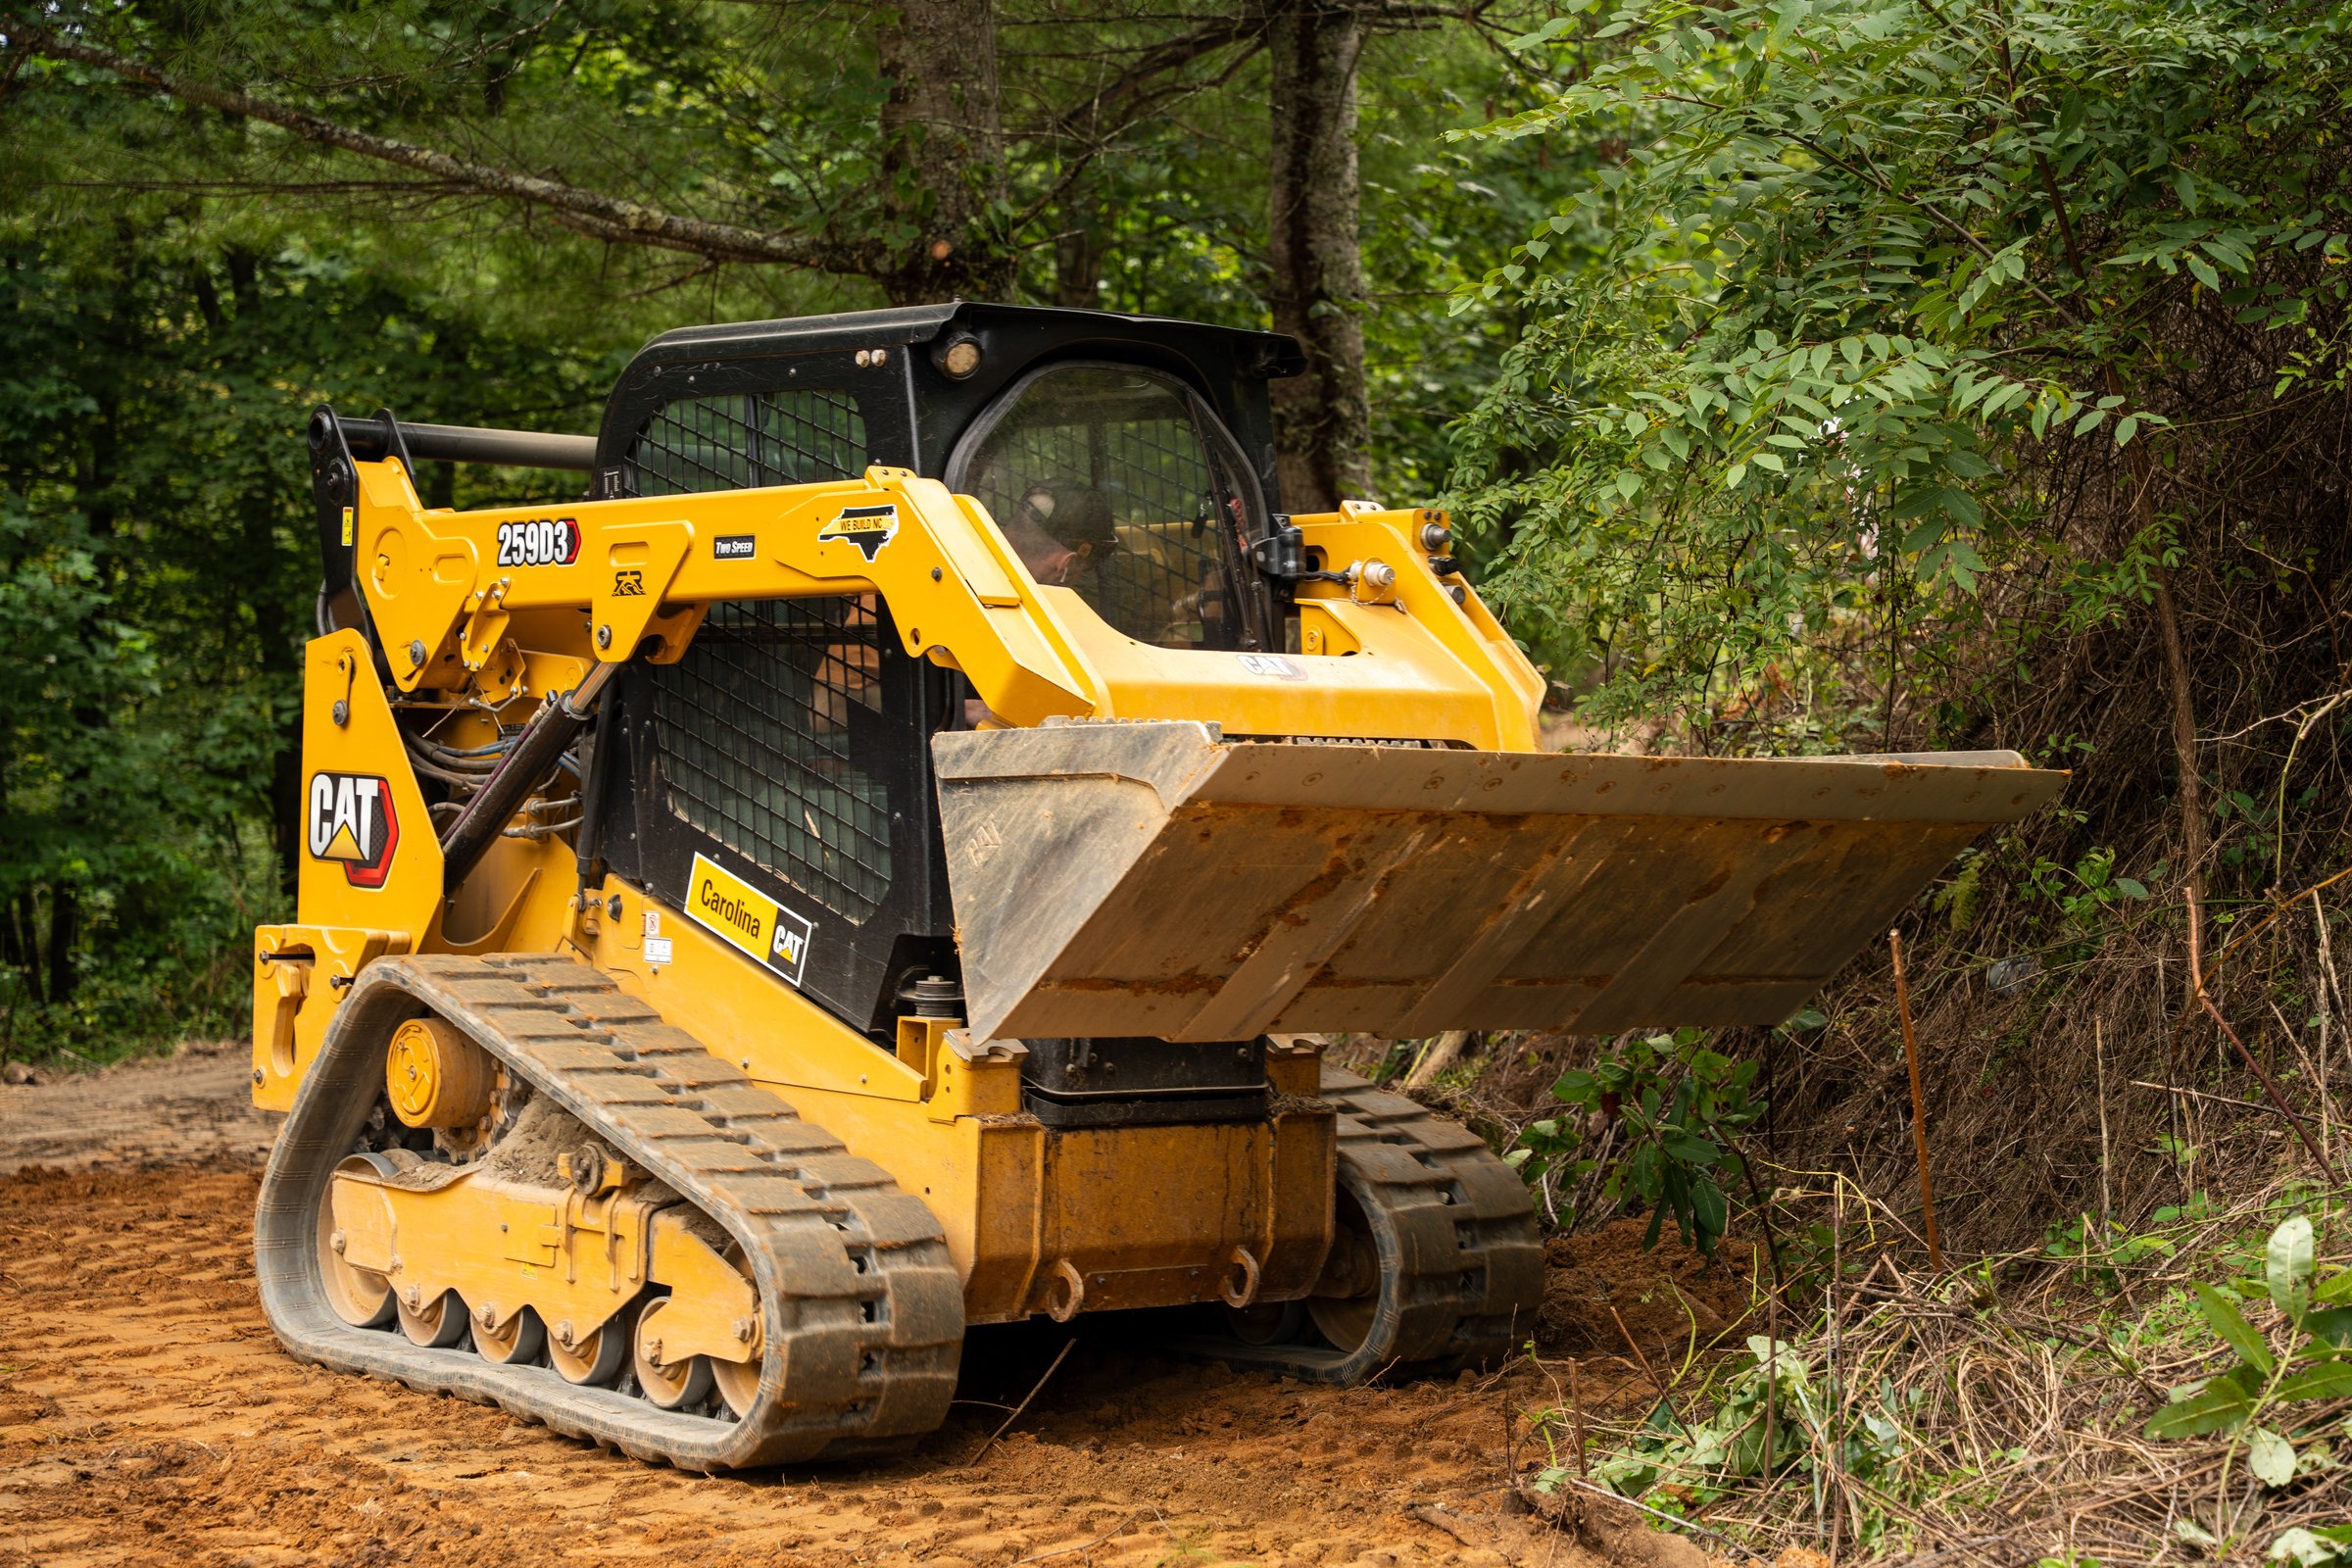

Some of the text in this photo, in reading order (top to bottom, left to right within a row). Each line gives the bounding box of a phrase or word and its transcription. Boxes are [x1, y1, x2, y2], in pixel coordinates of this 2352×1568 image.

[498, 520, 568, 564] 259D3
[840, 517, 883, 531] WE BUILD NC
[1237, 656, 1295, 676] CAT
[310, 773, 379, 860] CAT
[701, 878, 805, 965] Carolina CAT
